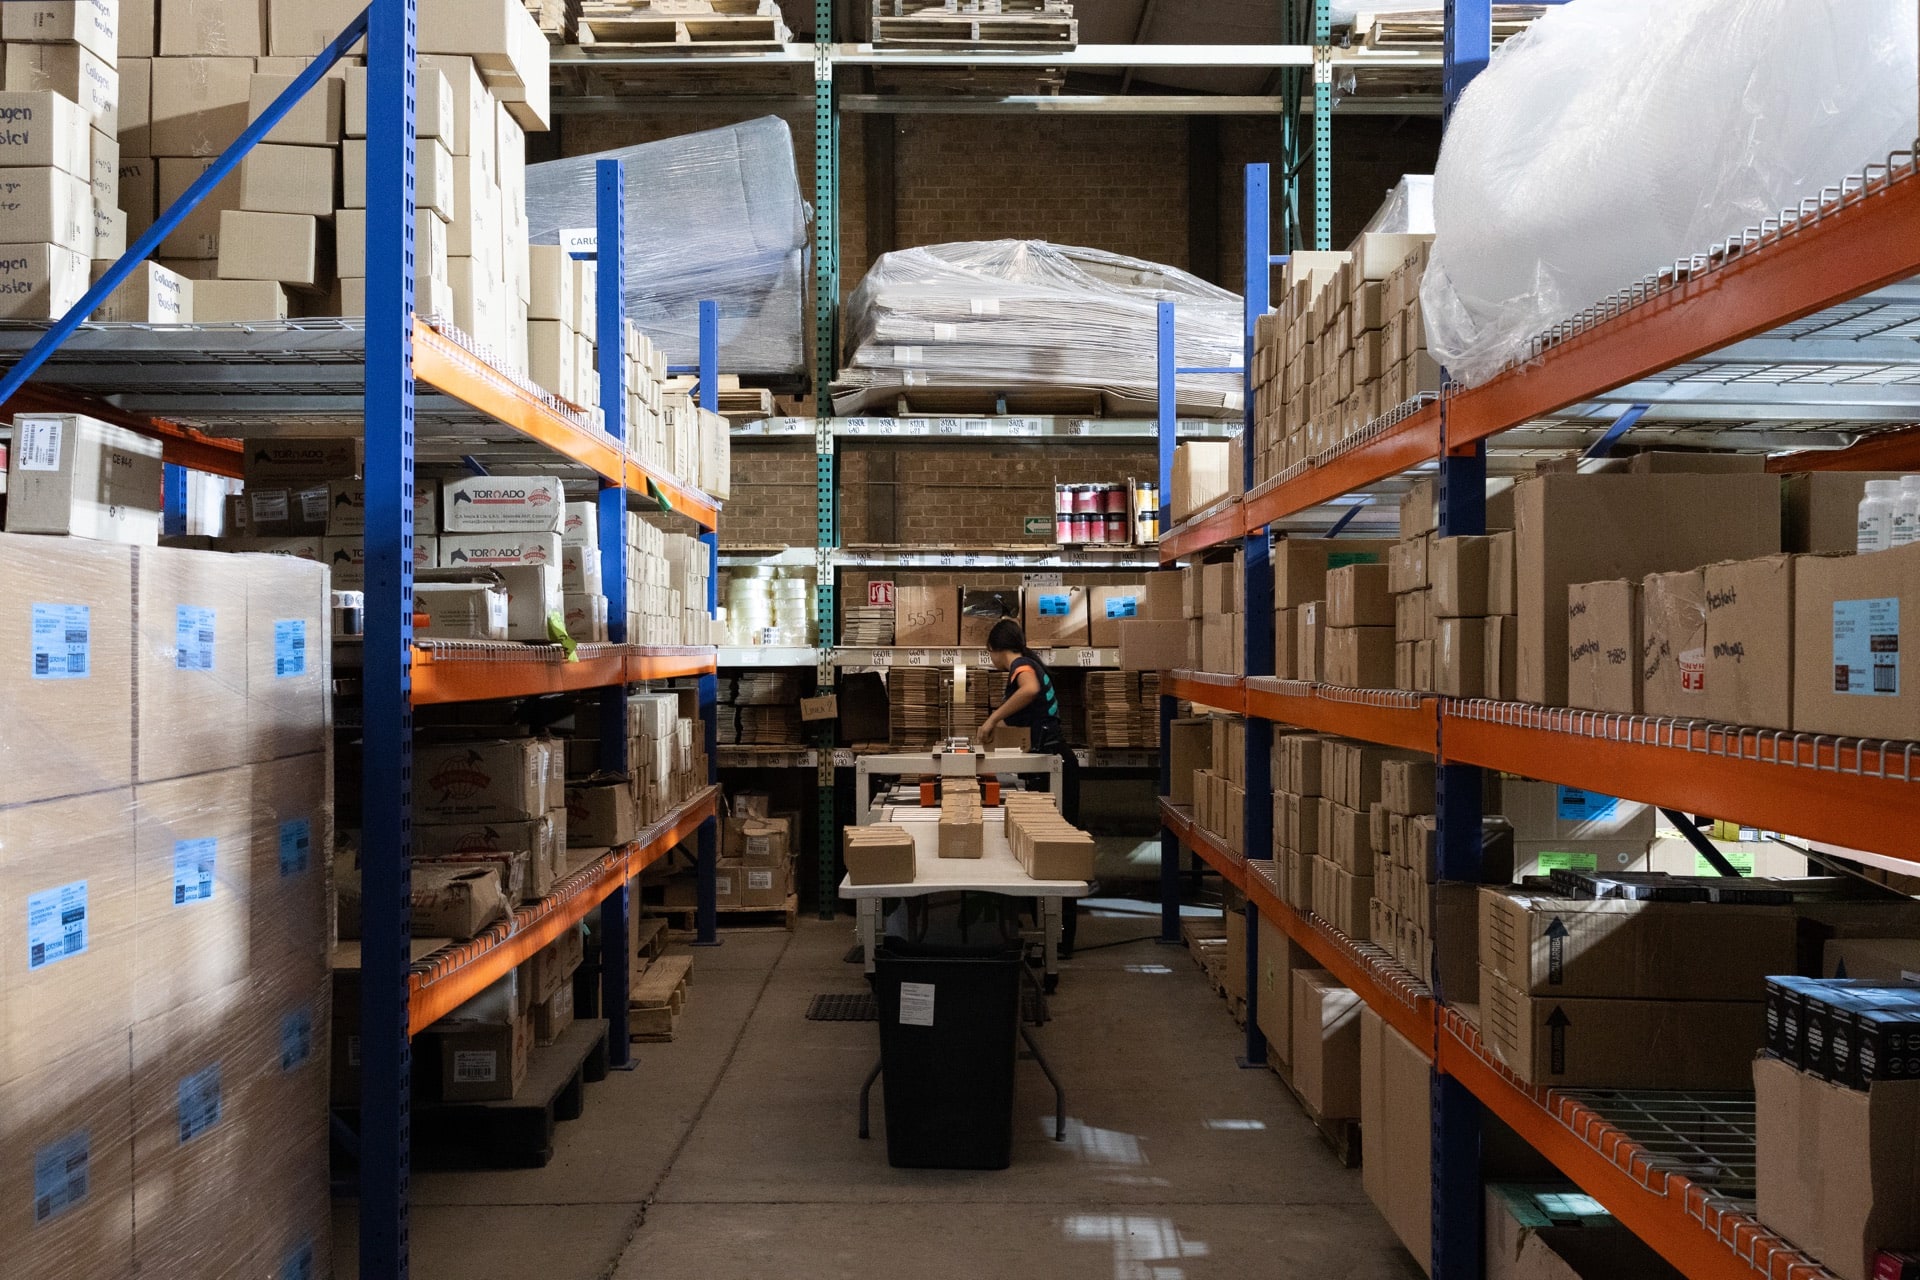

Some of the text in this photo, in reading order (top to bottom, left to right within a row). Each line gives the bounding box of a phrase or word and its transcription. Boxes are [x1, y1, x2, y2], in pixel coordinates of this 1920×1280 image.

[85, 62, 109, 89] Collagen
[154, 270, 181, 295] Collagen
[157, 292, 181, 314] Buster
[473, 489, 526, 498] TORNADO
[469, 548, 521, 557] TORNADO
[1551, 936, 1562, 960] ARRIBA
